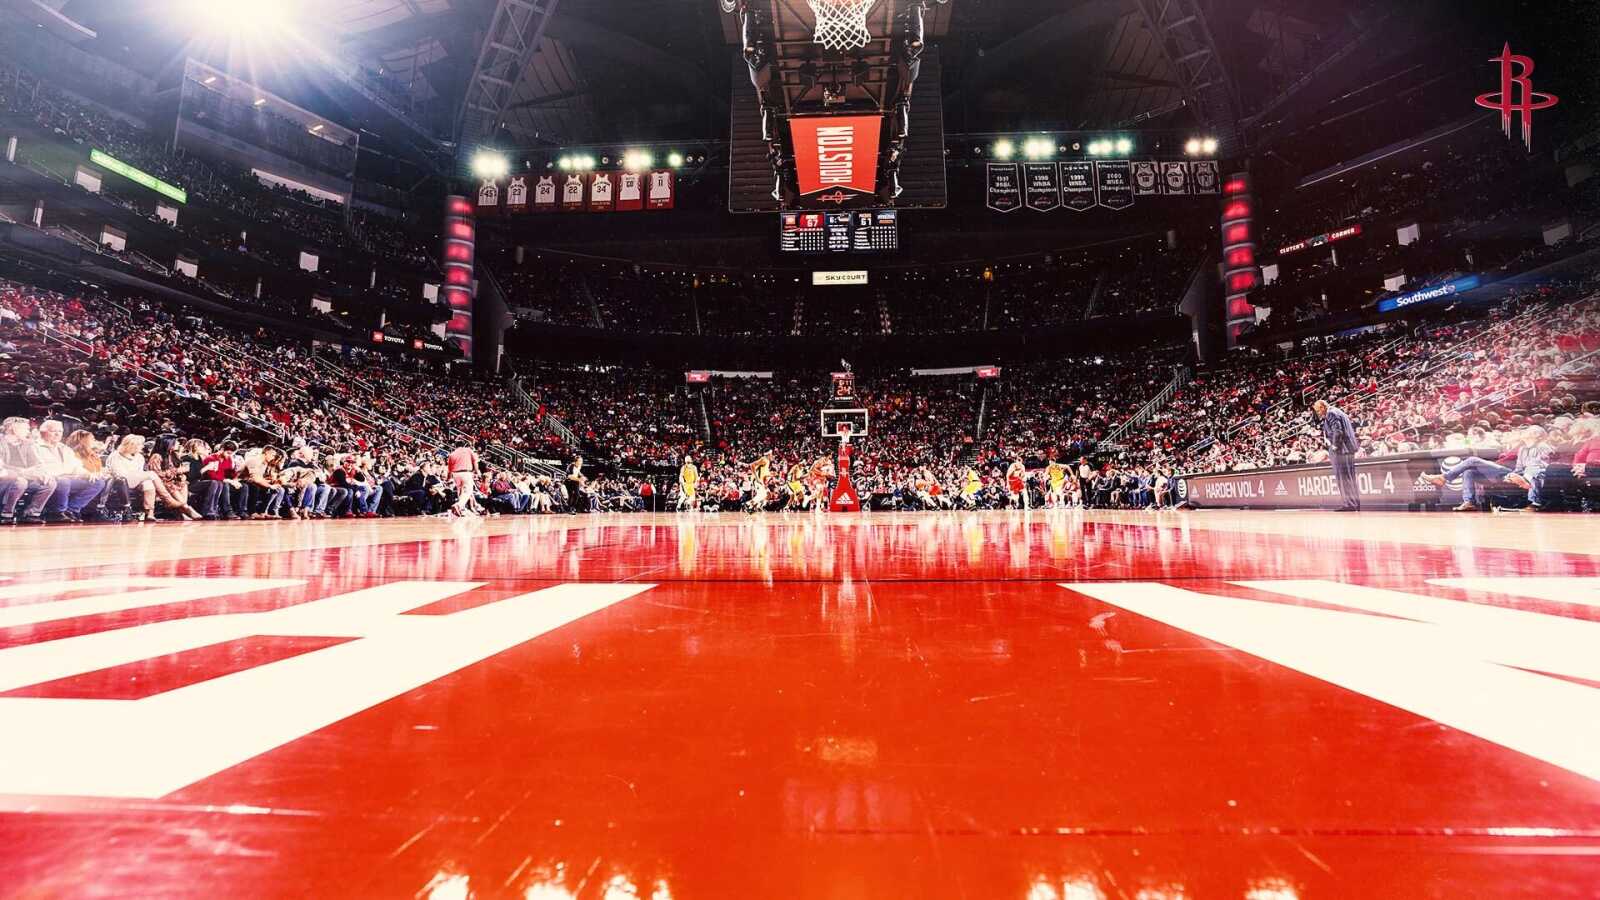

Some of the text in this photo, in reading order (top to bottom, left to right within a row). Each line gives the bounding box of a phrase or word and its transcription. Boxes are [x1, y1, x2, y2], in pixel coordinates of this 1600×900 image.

[816, 126, 854, 184] HOUSTON
[512, 188, 521, 196] 23
[540, 187, 550, 195] 24
[568, 186, 578, 194] 22
[596, 185, 606, 193] 34
[1396, 284, 1449, 307] Southwest
[384, 335, 405, 344] TOYOTA
[424, 342, 443, 351] TOYOTA
[1298, 475, 1341, 497] HARDE
[1383, 471, 1394, 494] 4
[1205, 482, 1236, 499] HARDEN
[1258, 479, 1265, 497] 4
